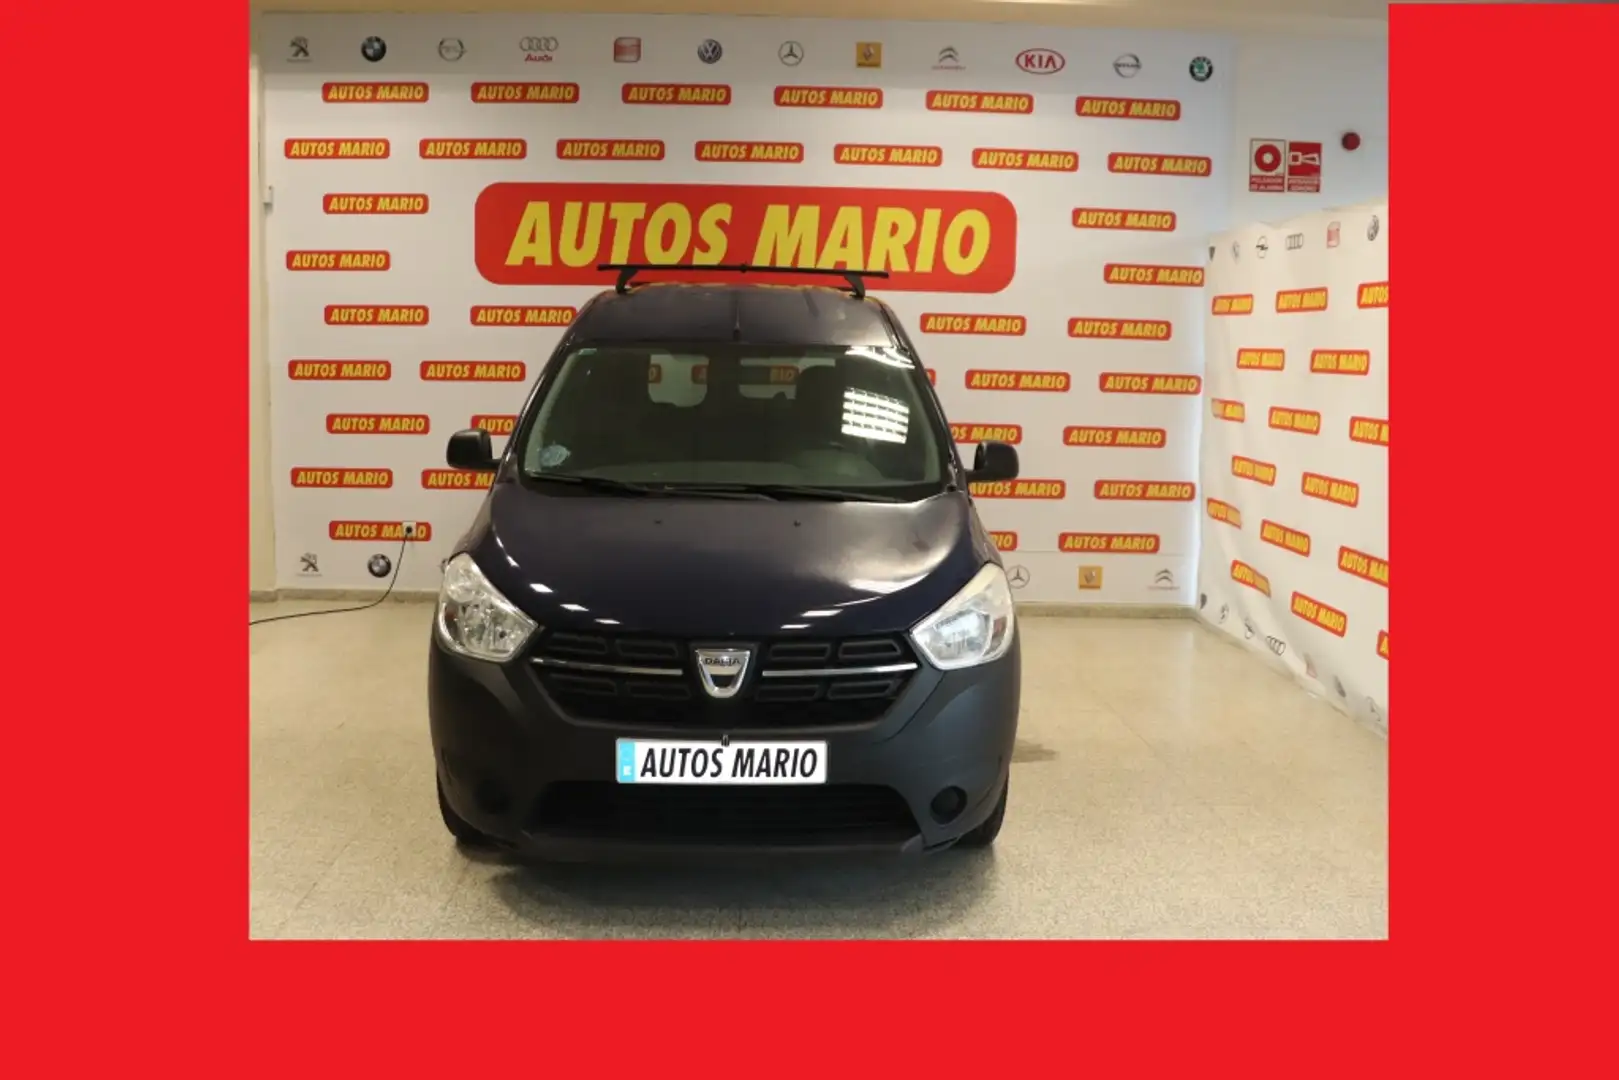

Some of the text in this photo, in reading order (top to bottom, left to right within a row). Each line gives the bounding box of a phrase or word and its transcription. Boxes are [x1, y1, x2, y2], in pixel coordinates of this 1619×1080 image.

[1024, 54, 1057, 69] KIA
[328, 86, 424, 100] AUTOS MARIO
[478, 87, 573, 100] AUTOS MARIO
[629, 88, 725, 101] AUTOS MARIO
[781, 91, 878, 106] AUTOS MARIO
[933, 94, 1029, 109] AUTOS MARIO
[1082, 101, 1176, 116] AUTOS MARIO
[291, 142, 385, 156] AUTOS MARIO
[426, 142, 521, 156] AUTOS MARIO
[564, 142, 660, 157] AUTOS MARIO
[702, 144, 800, 159] AUTOS MARIO
[841, 148, 938, 163] AUTOS MARIO
[979, 152, 1074, 168] AUTOS MARIO
[1115, 156, 1207, 172] AUTOS MARIO
[330, 197, 423, 210] AUTOS MARIO
[1078, 212, 1171, 228] AUTOS MARIO
[505, 200, 991, 276] AUTOS MARIO
[293, 254, 386, 267] AUTOS MARIO
[1110, 268, 1201, 283] AUTOS MARIO
[1278, 291, 1326, 309] AUTOS MARIO
[331, 309, 424, 322] AUTOS MARIO
[478, 310, 573, 323] AUTOS MARIO
[927, 317, 1021, 332] AUTOS MARIO
[1074, 322, 1168, 337] AUTOS MARIO
[1239, 352, 1283, 368] AUTOS MARIO
[1313, 353, 1368, 372] AUTOS MARIO
[295, 364, 386, 377] AUTOS MARIO
[428, 364, 520, 378] AUTOS MARIO
[972, 373, 1066, 388] AUTOS MARIO
[1106, 376, 1196, 392] AUTOS MARIO
[333, 418, 424, 431] AUTOS MARIO
[478, 418, 515, 432] AUTO
[1271, 411, 1319, 431] AUTOS MARIO
[970, 427, 1016, 442] MARIO
[1070, 430, 1161, 444] AUTOS MARIO
[1352, 420, 1379, 441] AUTOS
[298, 471, 388, 484] AUTOS MARIO
[1233, 459, 1275, 482] AUTOS MARIO
[427, 472, 471, 487] AUTOS
[970, 483, 1061, 496] AUTOS MARIO
[1101, 484, 1190, 498] AUTOS MARIO
[1304, 477, 1357, 503] AUTOS MARIO
[335, 524, 426, 539] AUTOS MAO
[1263, 524, 1309, 552] AUTOS MARIO
[1065, 536, 1154, 550] AUTOS MARIO
[1341, 551, 1369, 575] AUTOS
[1294, 596, 1345, 632] AUTOS MARIO
[640, 748, 818, 778] AUTOS MARIO
